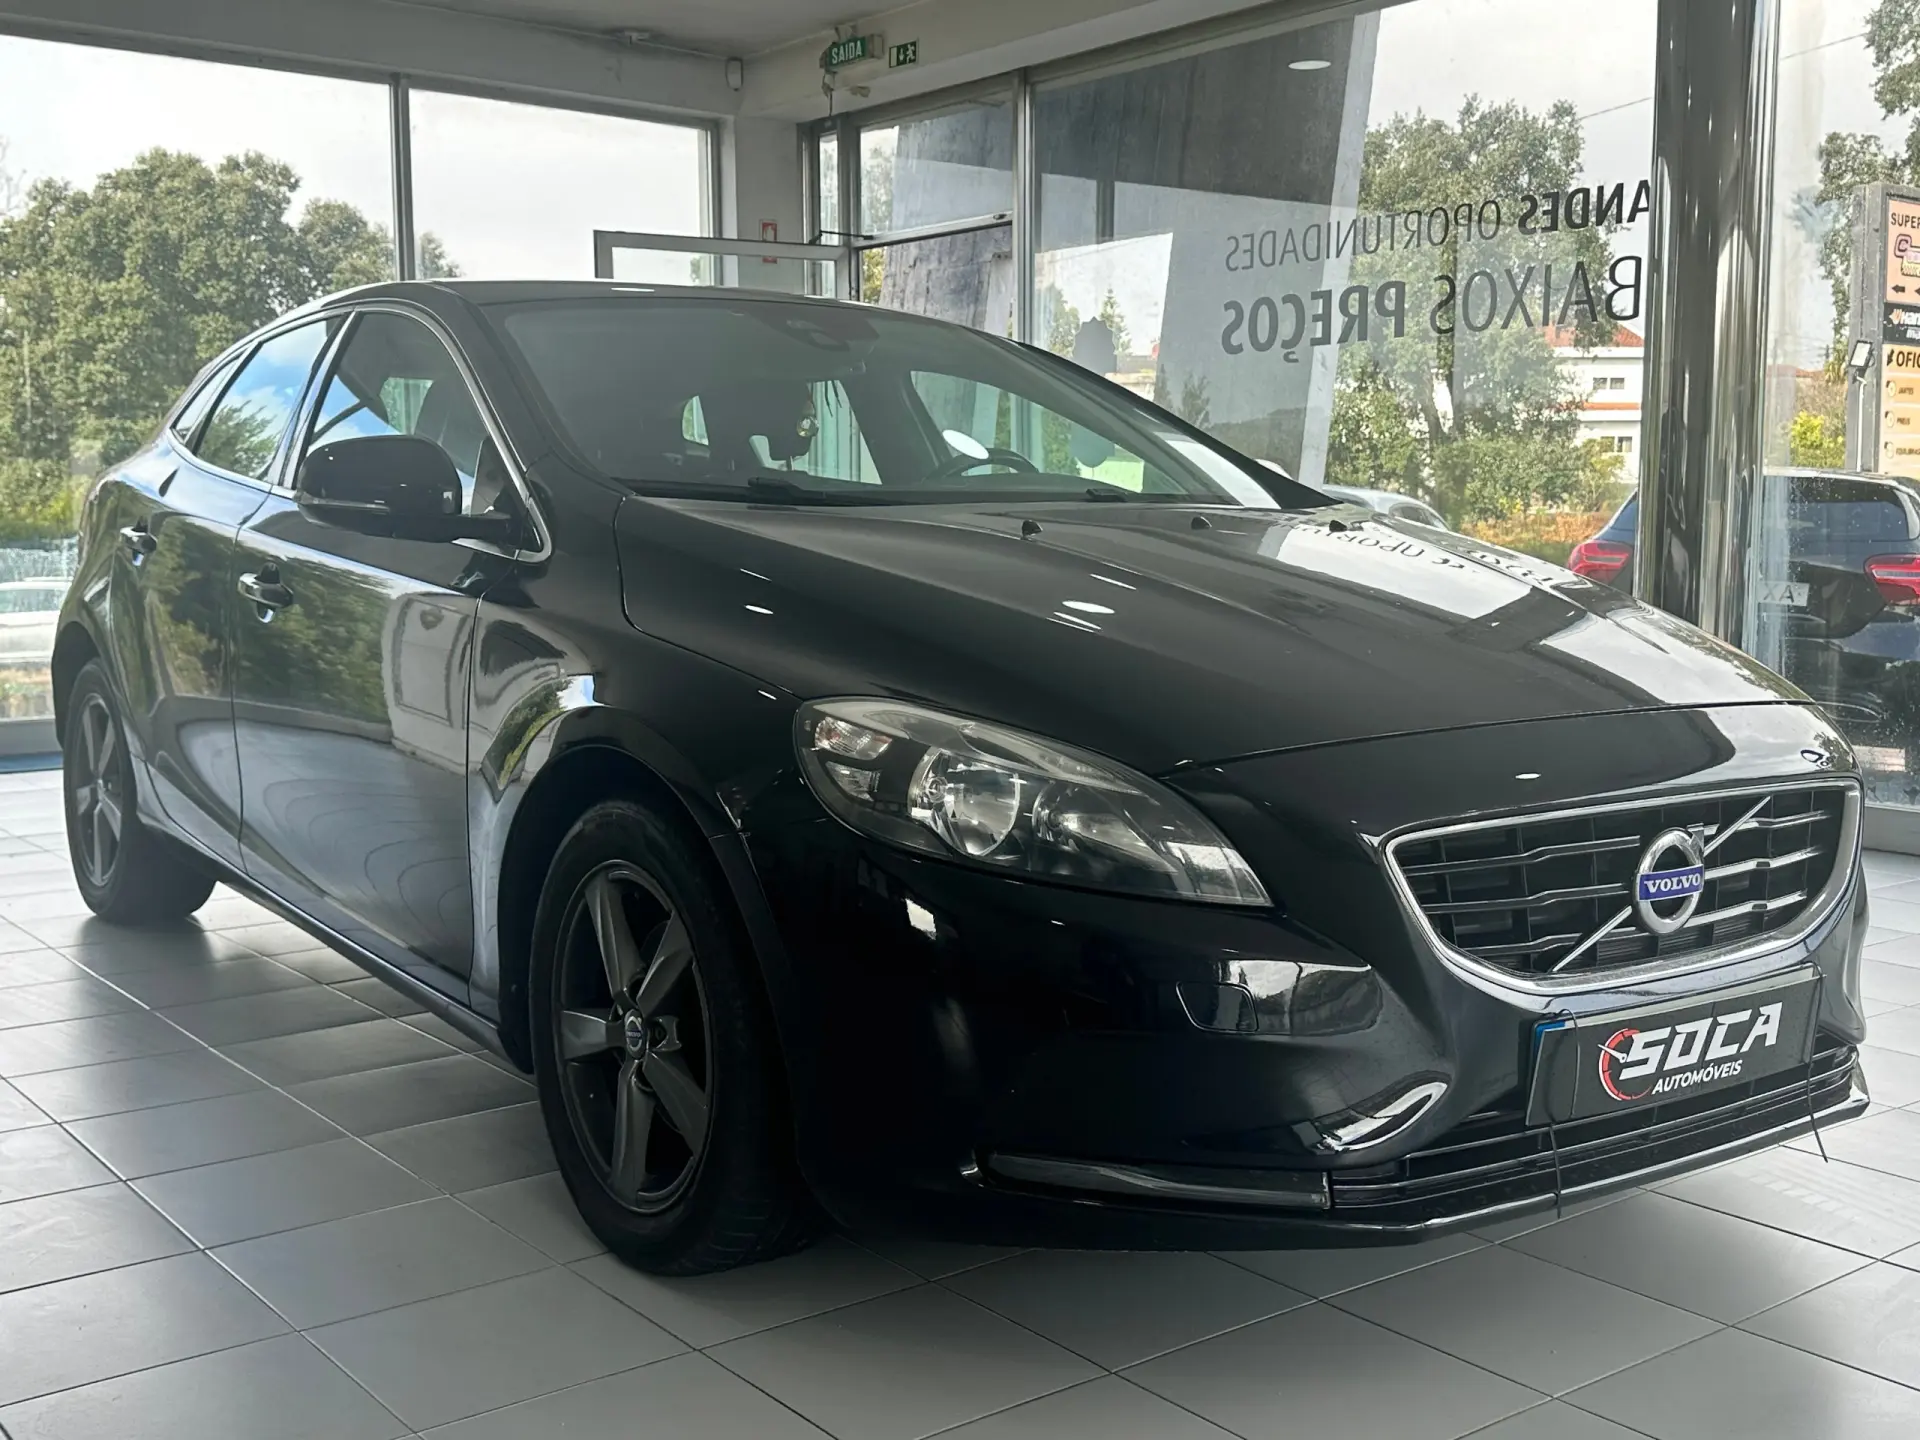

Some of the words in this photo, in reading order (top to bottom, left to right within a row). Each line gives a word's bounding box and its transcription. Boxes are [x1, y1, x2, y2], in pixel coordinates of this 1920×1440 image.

[1644, 873, 1701, 893] VOLVO
[1619, 1002, 1782, 1081] SOCA
[1651, 1059, 1743, 1095] AUTOMÓVEIS
